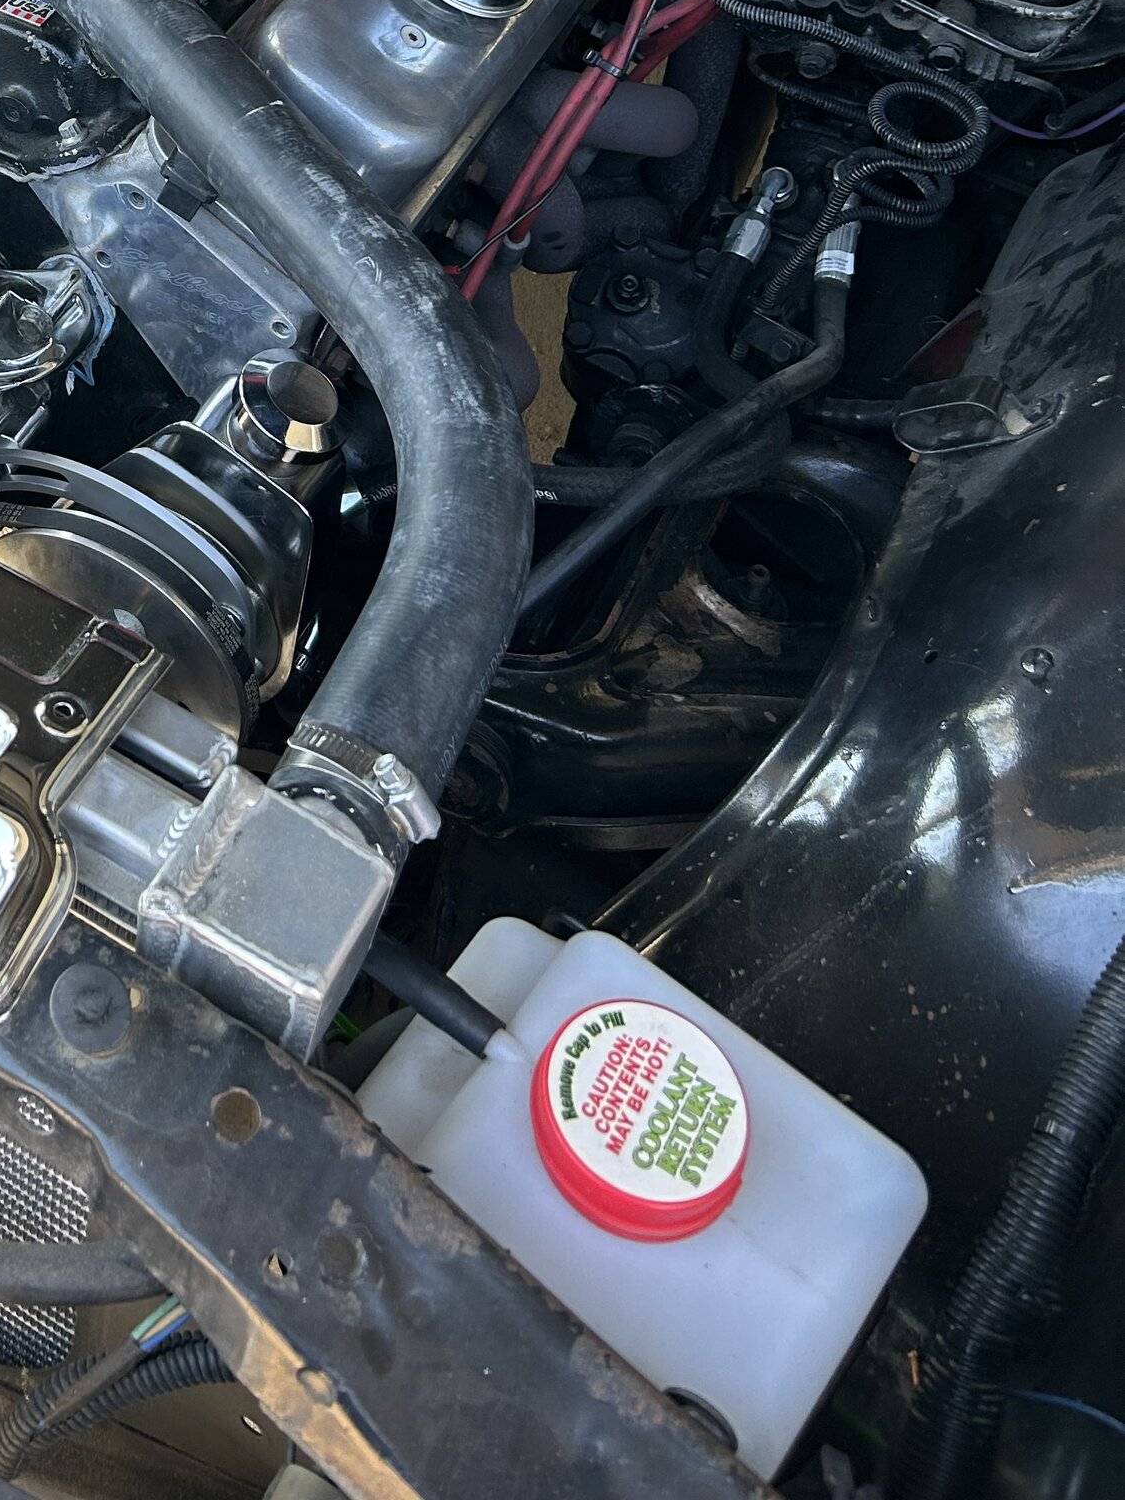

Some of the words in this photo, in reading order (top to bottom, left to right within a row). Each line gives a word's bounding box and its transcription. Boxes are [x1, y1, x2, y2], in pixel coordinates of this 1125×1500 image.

[114, 248, 268, 322] Edelbrock
[565, 1032, 592, 1060] Cap
[586, 1020, 603, 1038] to
[599, 1010, 627, 1030] Fill
[560, 1059, 581, 1122] Remove
[580, 1032, 636, 1120] CAUTION:
[594, 1036, 652, 1136] CONTENTS
[605, 1112, 636, 1156] MAY
[629, 1085, 651, 1114] BE
[646, 1036, 673, 1086] HOT!
[631, 1051, 700, 1171] COOLANT
[655, 1076, 717, 1178] RETURN
[679, 1092, 738, 1188] SYSTEM
